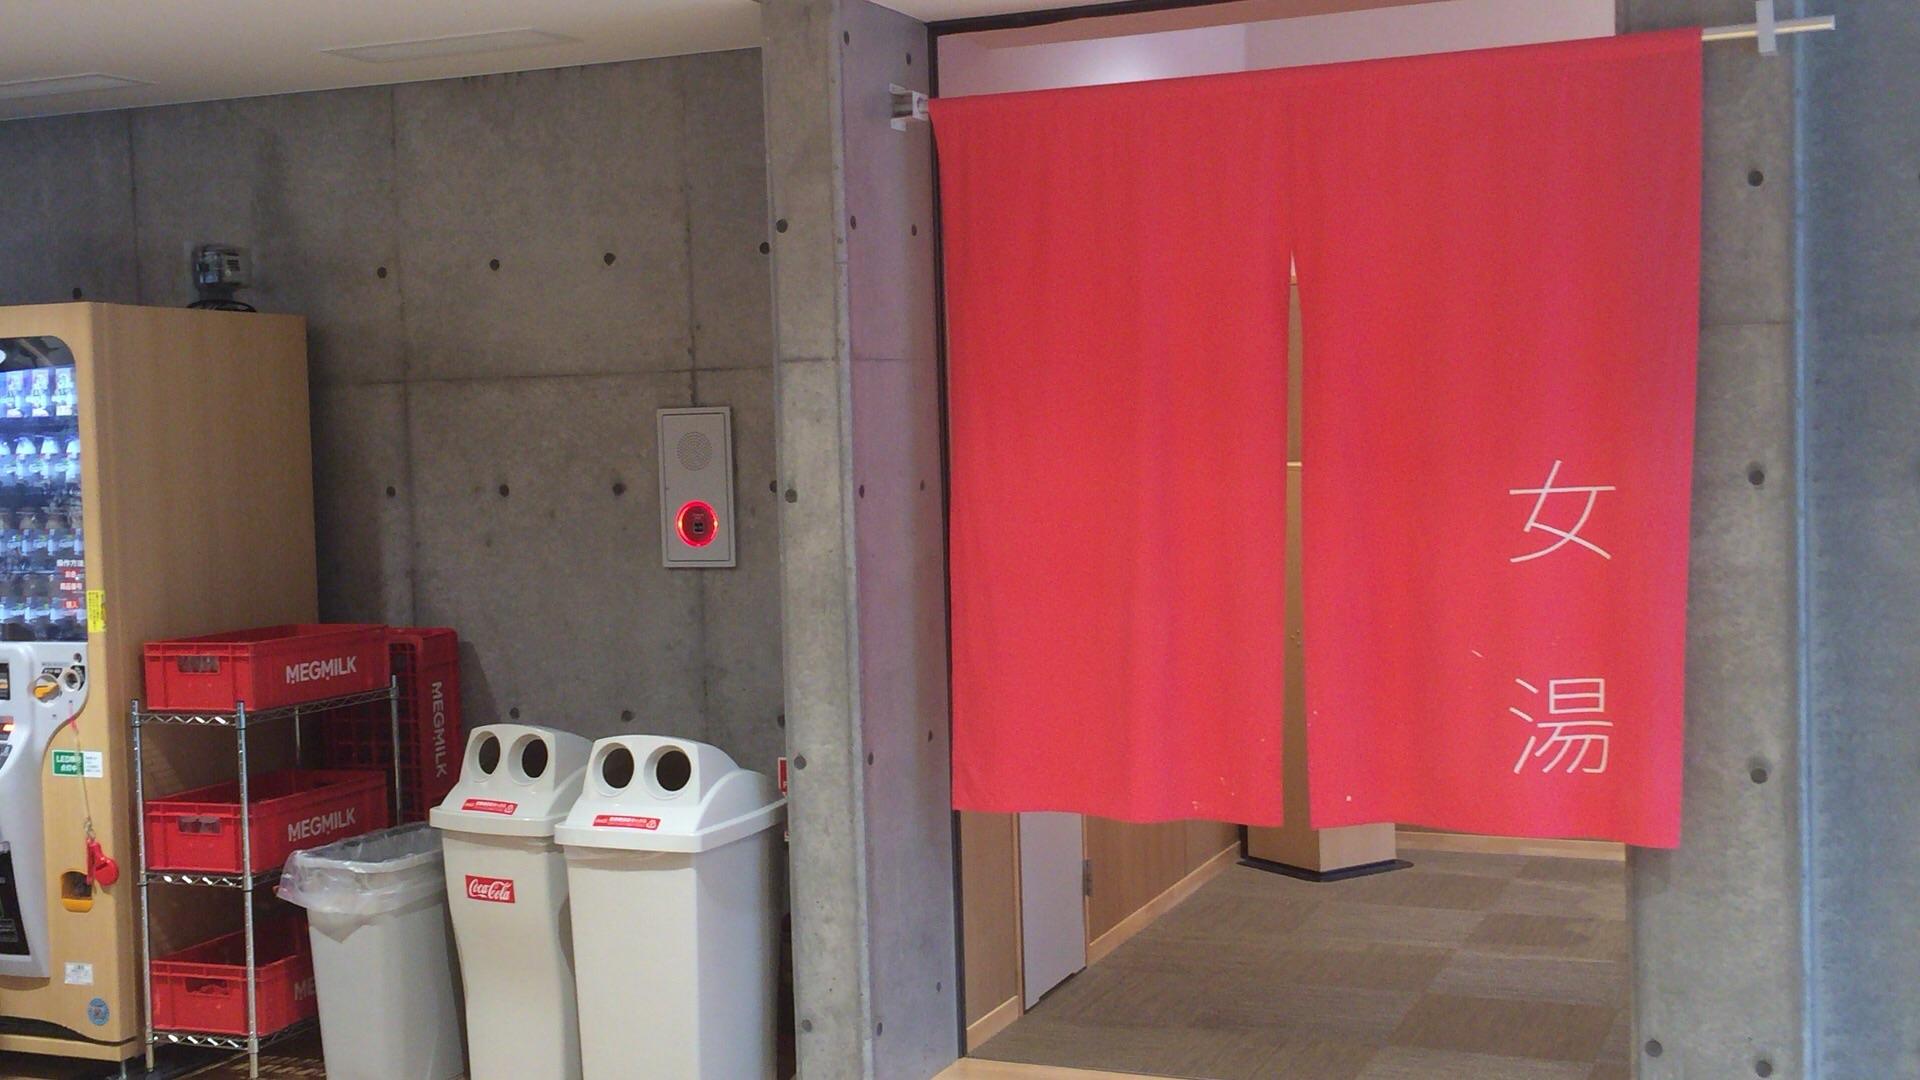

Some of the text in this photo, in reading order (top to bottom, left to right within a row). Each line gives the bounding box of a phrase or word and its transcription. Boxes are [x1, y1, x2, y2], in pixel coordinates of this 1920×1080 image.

[1509, 460, 1616, 774] 女湯
[286, 655, 357, 684] MEGMILK
[432, 681, 448, 778] MEGMILK
[288, 807, 356, 841] MEGMILK
